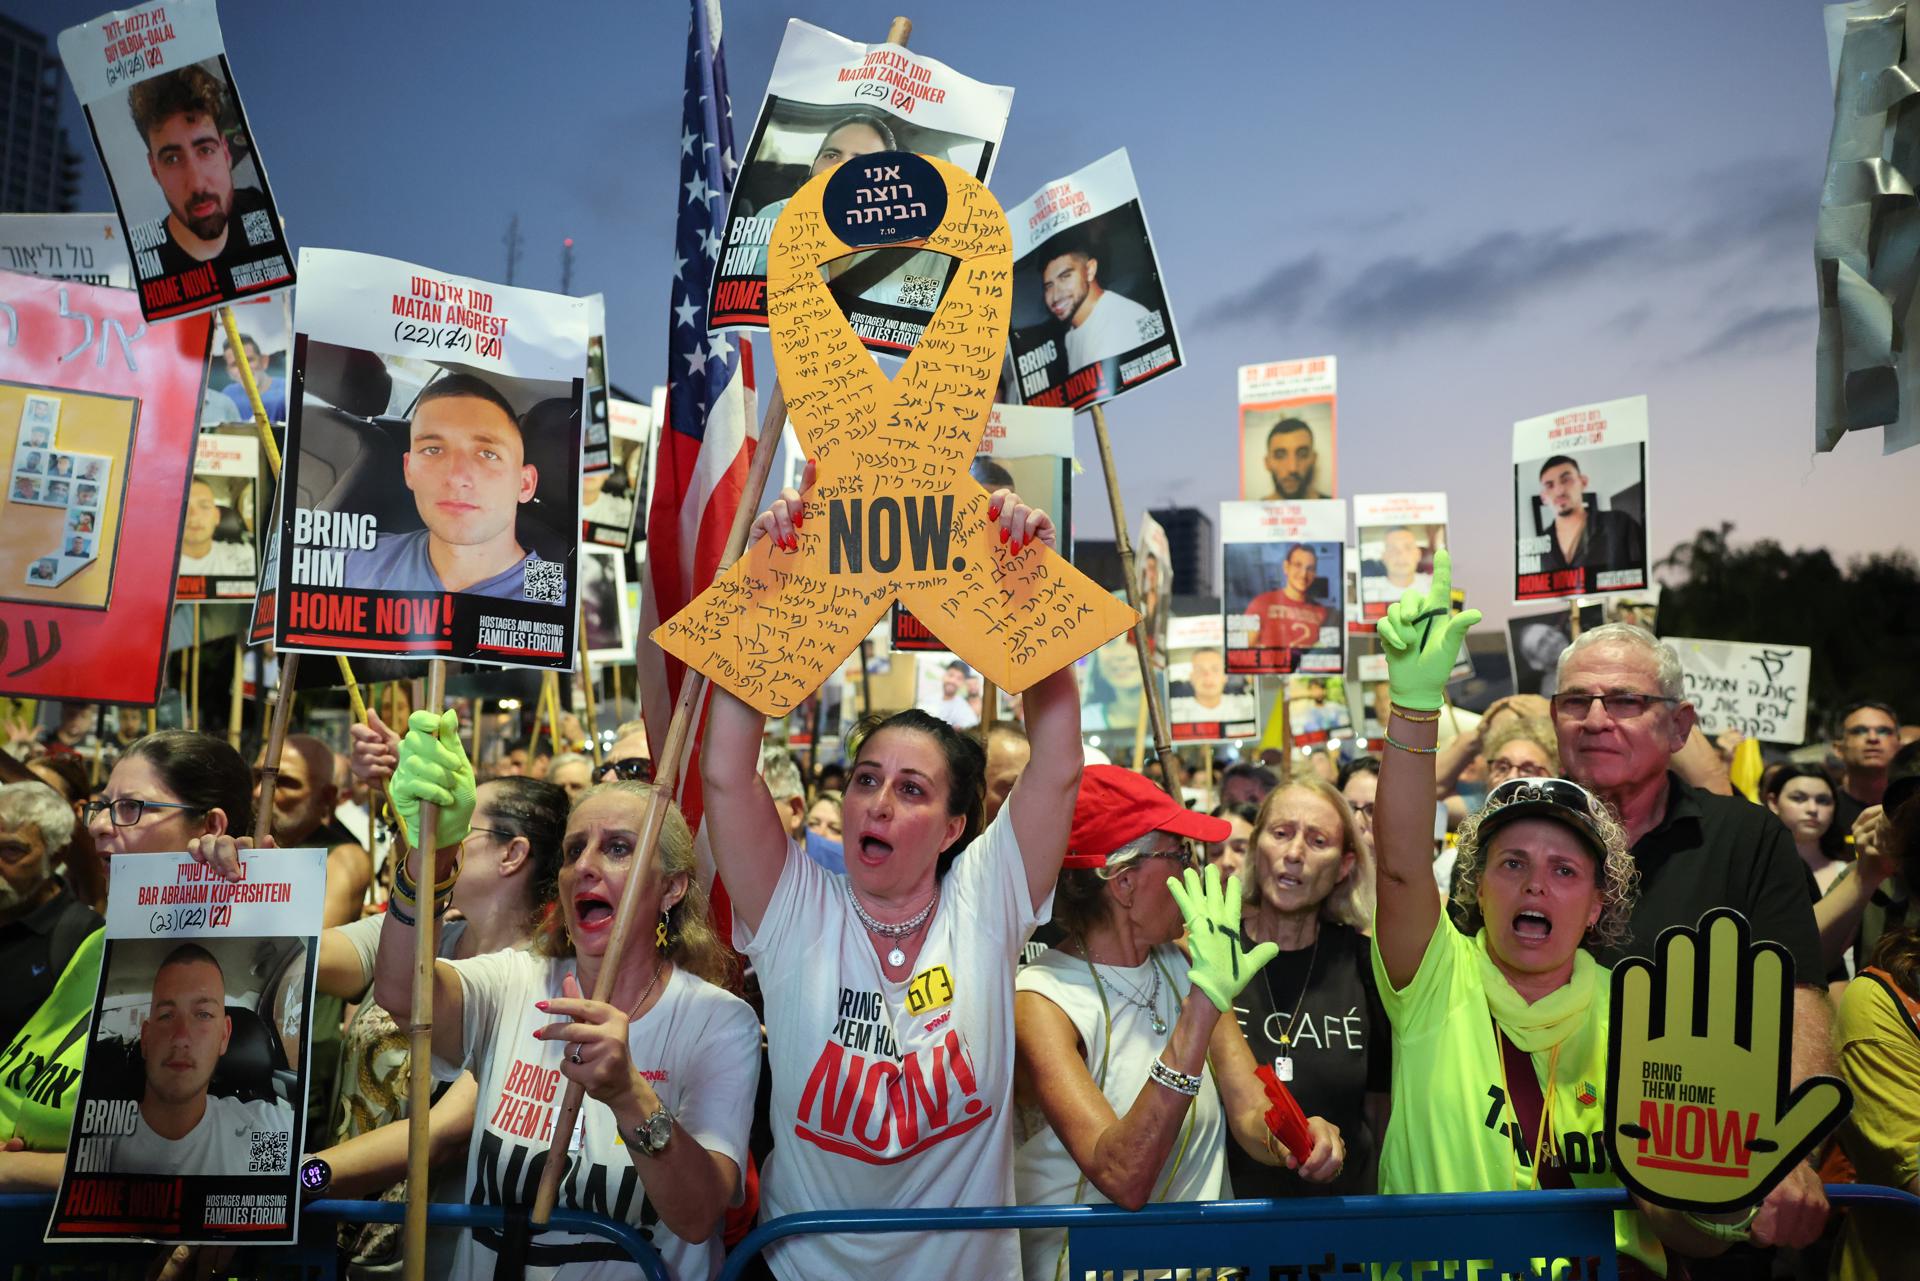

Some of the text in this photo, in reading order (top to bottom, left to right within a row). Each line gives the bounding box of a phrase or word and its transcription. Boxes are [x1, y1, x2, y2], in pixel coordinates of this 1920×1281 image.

[908, 62, 932, 84] מתן
[838, 66, 946, 105] MATAN ZANGAUKER
[854, 82, 890, 101] (25)
[864, 165, 901, 183] אני
[856, 183, 913, 204] רוצה
[963, 191, 978, 207] חן
[794, 211, 821, 222] דוד
[846, 202, 927, 225] הביתה
[130, 219, 167, 253] BRING
[727, 216, 778, 246] BRIN
[880, 227, 896, 236] 7.10
[66, 243, 94, 269] טל
[776, 241, 828, 257] אריאל
[136, 249, 164, 281] HIM
[720, 246, 759, 277] HIM
[143, 260, 220, 310] HOME NOW!
[232, 263, 289, 289] FAMILIES FORUM
[967, 269, 1009, 285] איתן
[468, 289, 493, 314] מתן
[714, 280, 768, 311] HOME
[969, 285, 1003, 298] מור
[391, 294, 509, 337] MATAN ANGREST
[849, 311, 885, 327] HOSTAGES
[884, 319, 900, 330] AND
[940, 301, 974, 318] ברמן
[930, 319, 1000, 339] זיו ברמן
[826, 341, 848, 355] טל
[1018, 340, 1058, 375] BRING
[1022, 367, 1050, 397] HIM
[1065, 362, 1105, 401] NOW!
[836, 384, 874, 404] דרור
[877, 436, 921, 450] אדר
[932, 425, 972, 443] אלון
[922, 464, 957, 477] רום
[294, 507, 378, 551] BRING
[828, 494, 967, 575] NOW.
[291, 547, 346, 588] HIM
[1018, 564, 1048, 585] סהר
[905, 577, 948, 590] מוחמד
[706, 595, 747, 615] דניאל
[830, 585, 864, 607] מתן
[986, 577, 1066, 635] אביתר דוד
[288, 591, 455, 637] HOME NOW!
[479, 614, 564, 637] HOSTAGES AND MISSING
[704, 609, 730, 627] פרץ
[478, 627, 564, 654] FAMILIES FORUM
[796, 636, 836, 655] איתן
[767, 670, 806, 689] איתן
[770, 689, 791, 708] בר
[138, 883, 293, 906] BAR ABRAHAM KUPERSHTEIN
[907, 965, 954, 1013] 673
[838, 987, 884, 1022] RING
[1263, 1006, 1364, 1051] CAFÉ
[504, 1059, 561, 1104] BRING
[1641, 1061, 1682, 1083] BRING
[797, 1029, 983, 1151] NOW!
[1641, 1079, 1716, 1105] THEM HOME
[81, 1099, 139, 1137] BRING
[490, 1092, 543, 1140] THEM
[1637, 1100, 1761, 1167] NOW
[74, 1136, 113, 1173] HIM
[65, 1177, 183, 1219] HOME NOW!
[206, 1194, 287, 1208] HOSTAGES AND MISSING
[204, 1207, 287, 1225] FAMILIES FORUM
